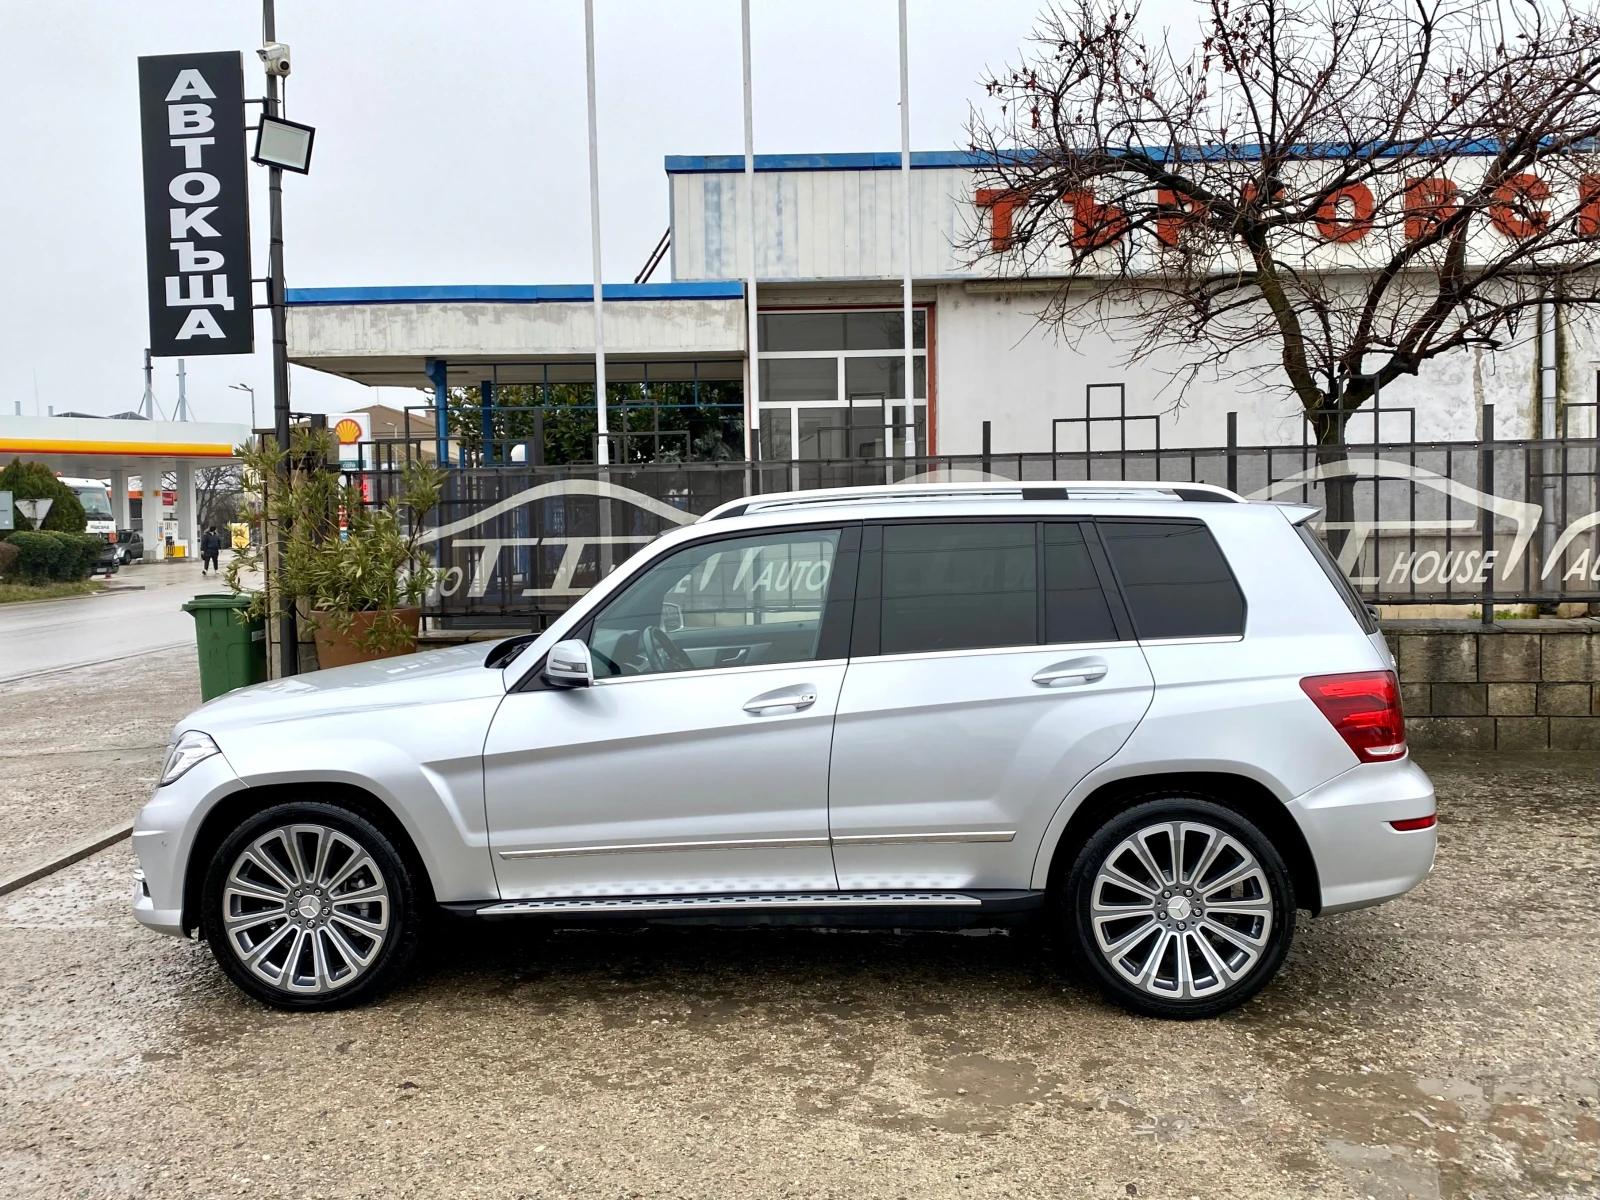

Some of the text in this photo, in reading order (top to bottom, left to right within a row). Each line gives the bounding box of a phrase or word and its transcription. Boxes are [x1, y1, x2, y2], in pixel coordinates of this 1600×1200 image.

[165, 69, 234, 340] АВТОКЪЩА
[751, 560, 831, 592] AUTO
[1387, 550, 1499, 584] HOUSE
